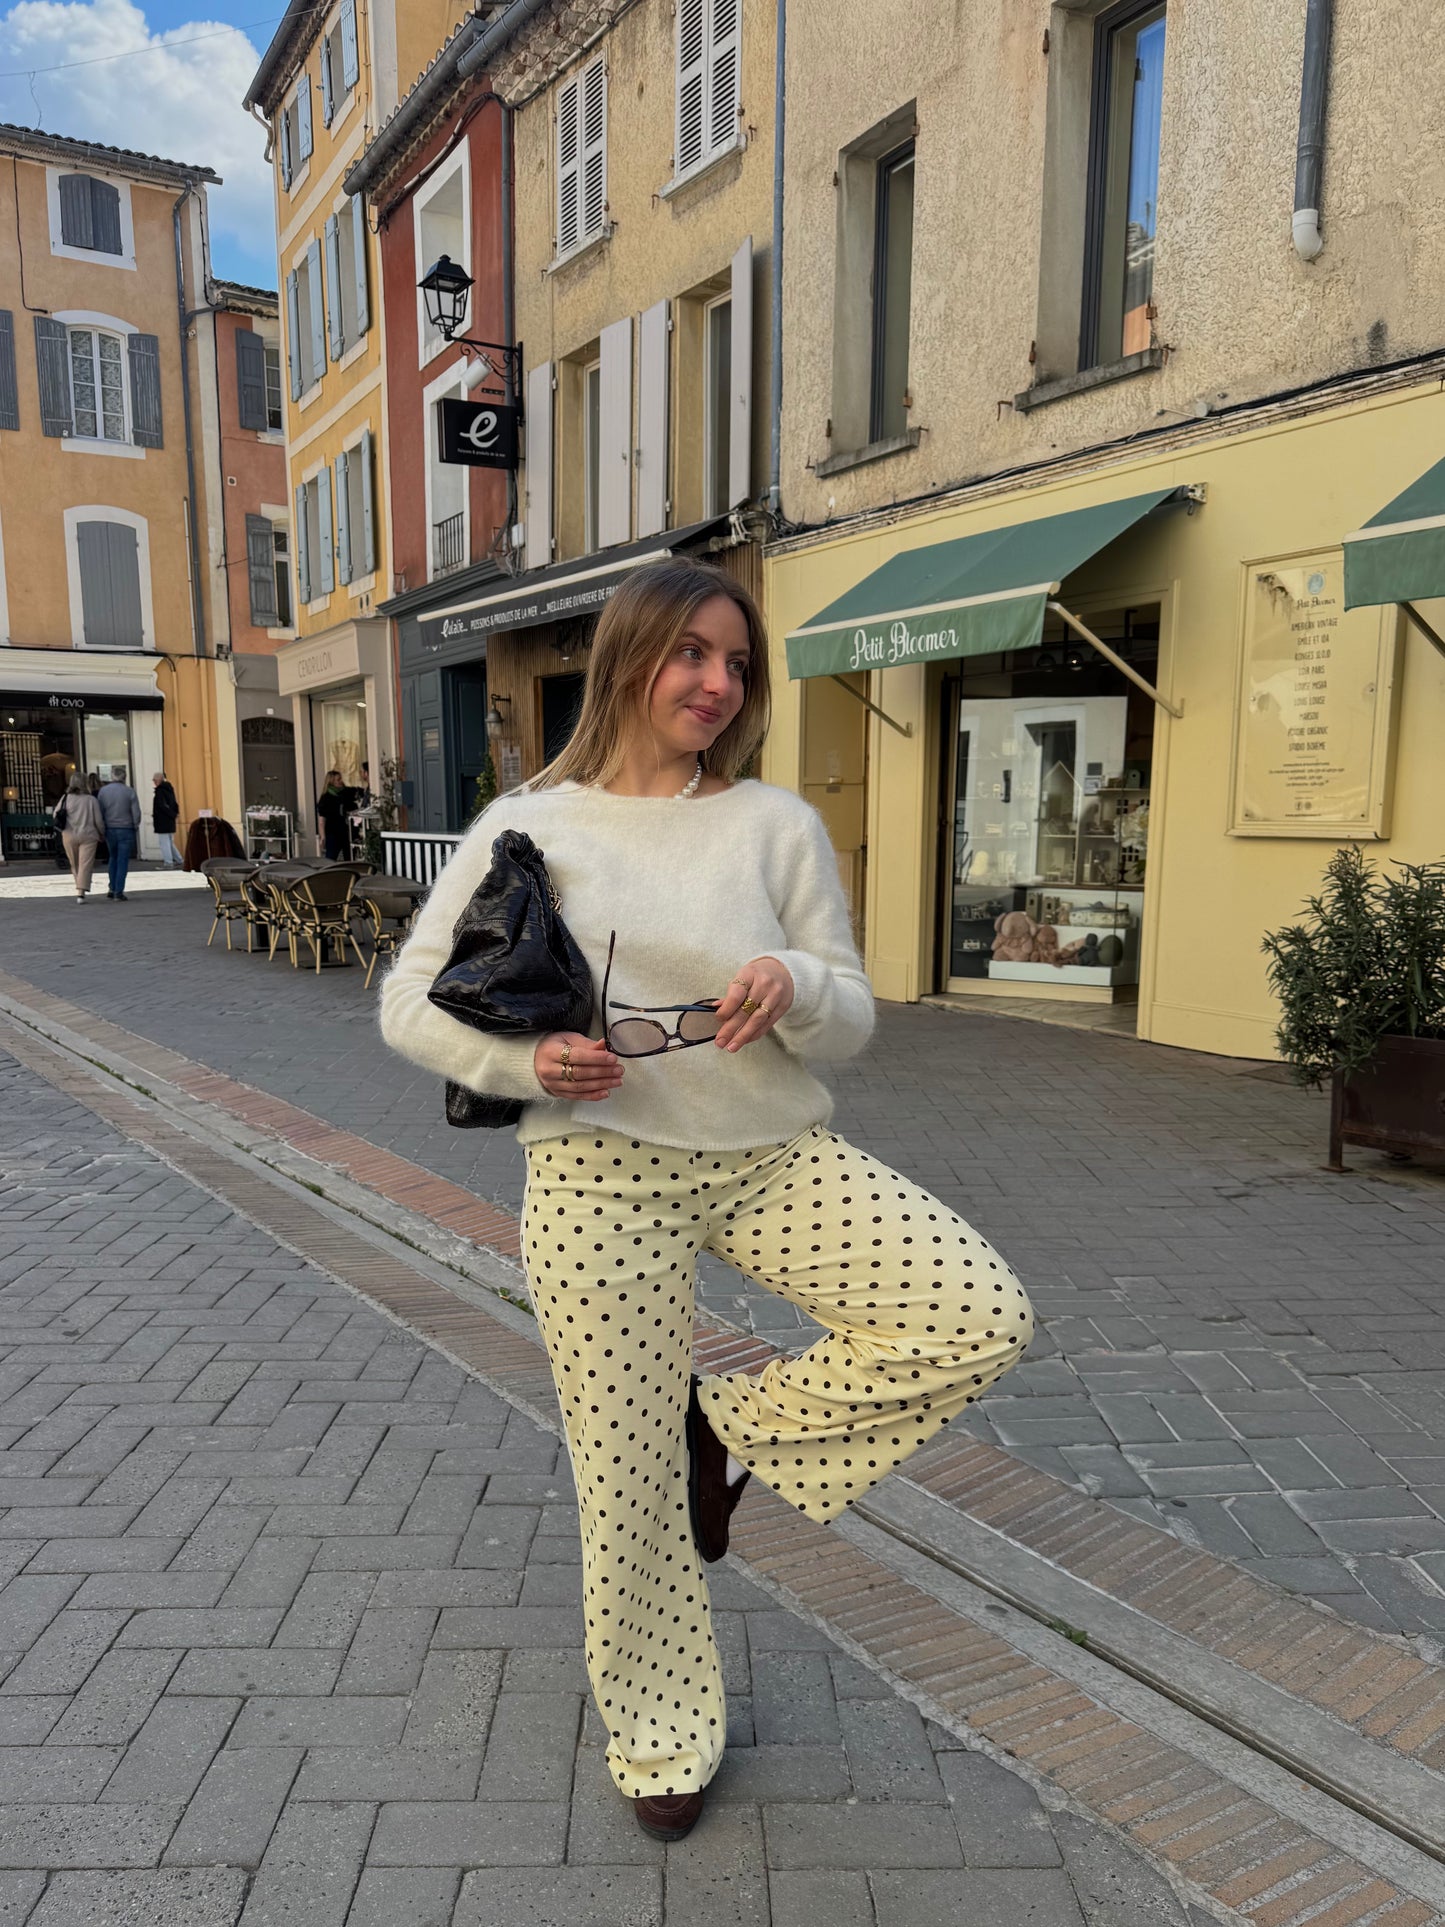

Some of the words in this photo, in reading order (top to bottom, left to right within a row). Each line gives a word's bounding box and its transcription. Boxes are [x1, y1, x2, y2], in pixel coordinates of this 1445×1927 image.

[514, 608, 521, 620] DE
[521, 607, 527, 619] LA
[528, 605, 538, 617] MER
[598, 588, 605, 601] DE
[850, 629, 885, 669] Petit
[887, 621, 960, 663] Bloomer
[61, 698, 85, 708] OVIO
